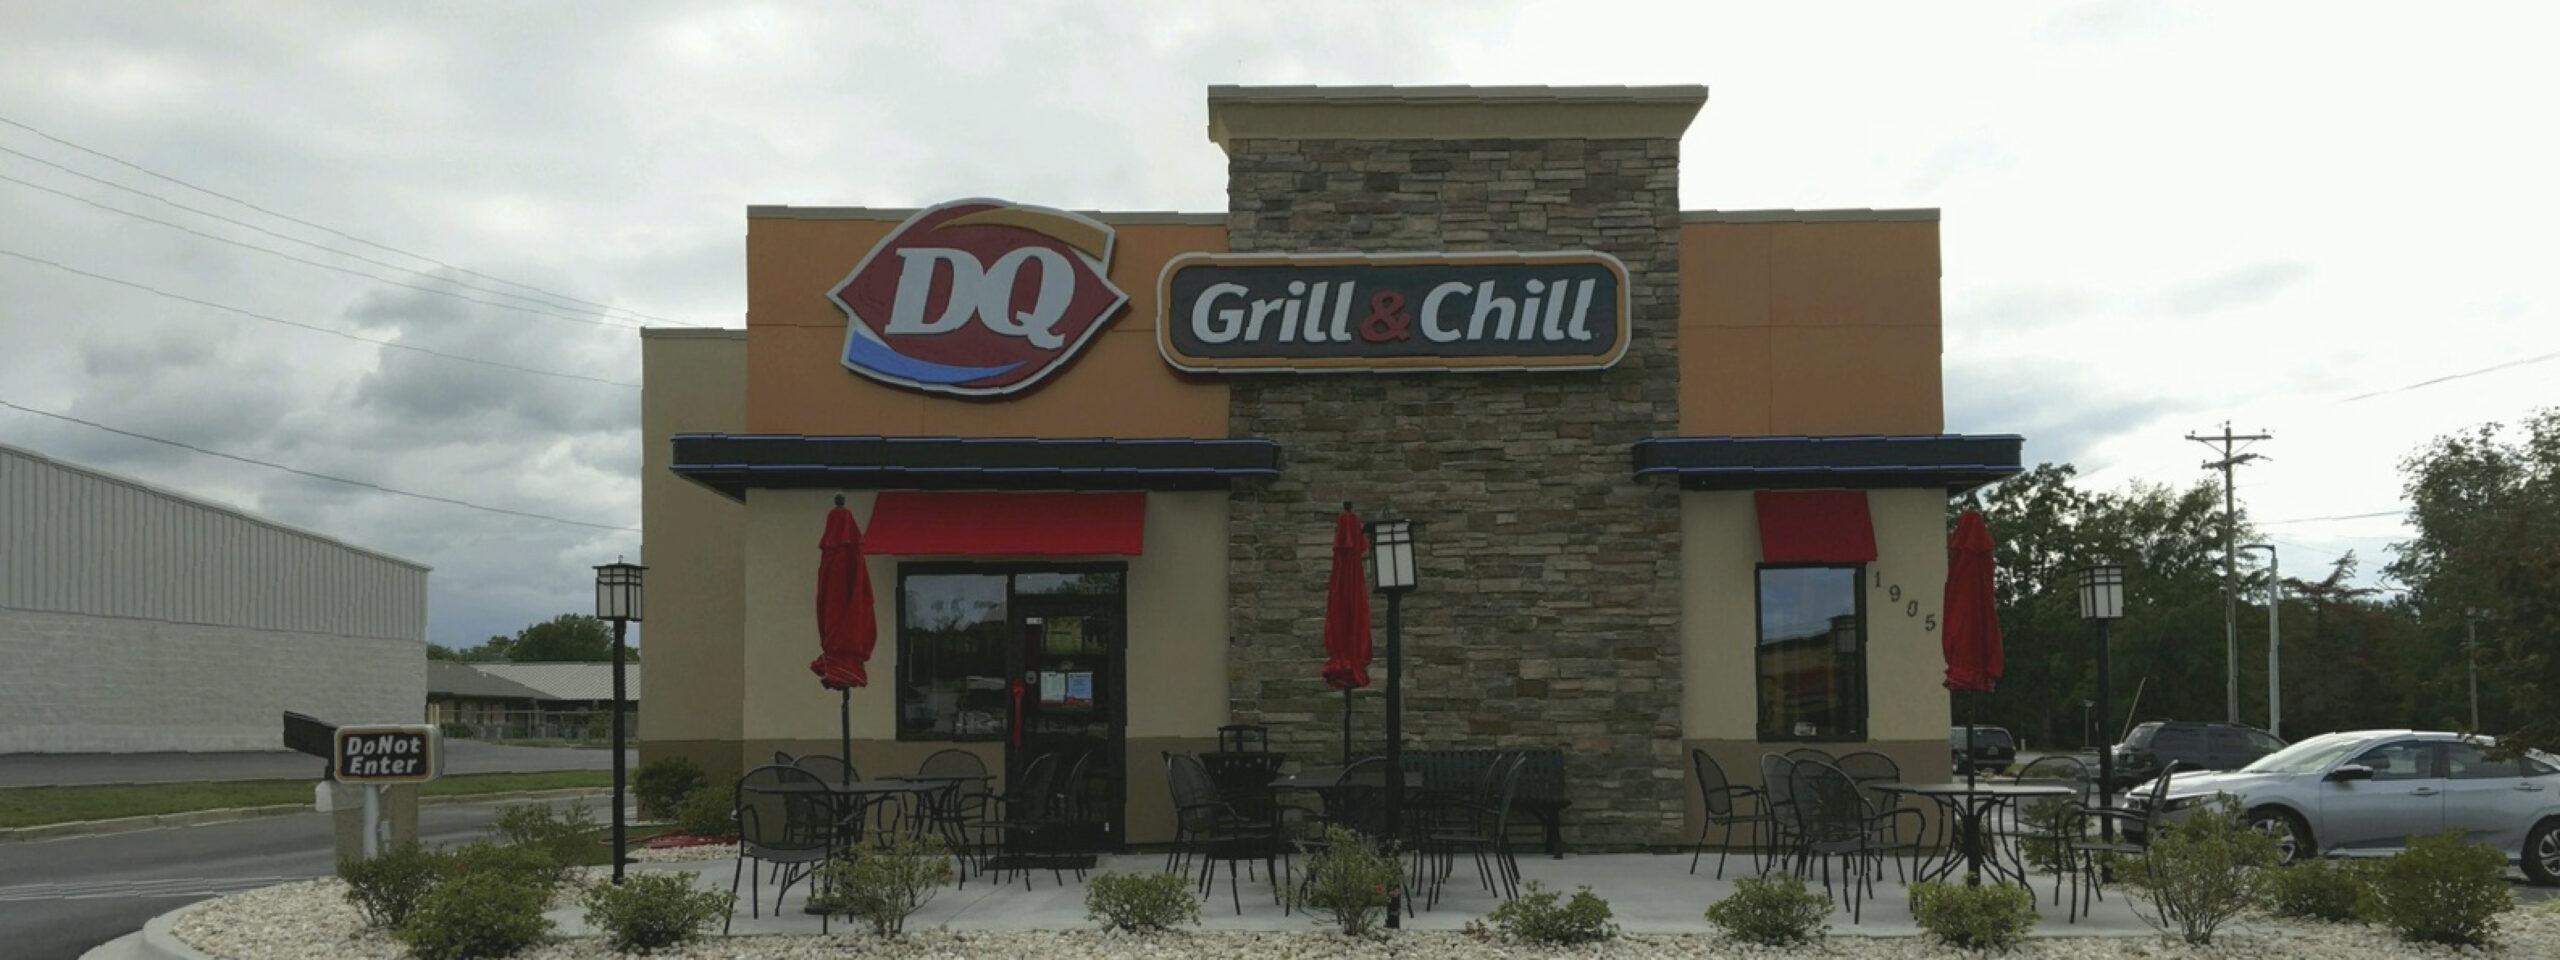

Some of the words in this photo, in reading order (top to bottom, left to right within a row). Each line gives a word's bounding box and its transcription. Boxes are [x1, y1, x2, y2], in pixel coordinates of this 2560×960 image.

[884, 246, 1075, 350] DQ
[1191, 280, 1355, 343] Grill
[1360, 290, 1412, 342] &
[1420, 279, 1596, 342] Chill
[350, 756, 418, 775] Enter
